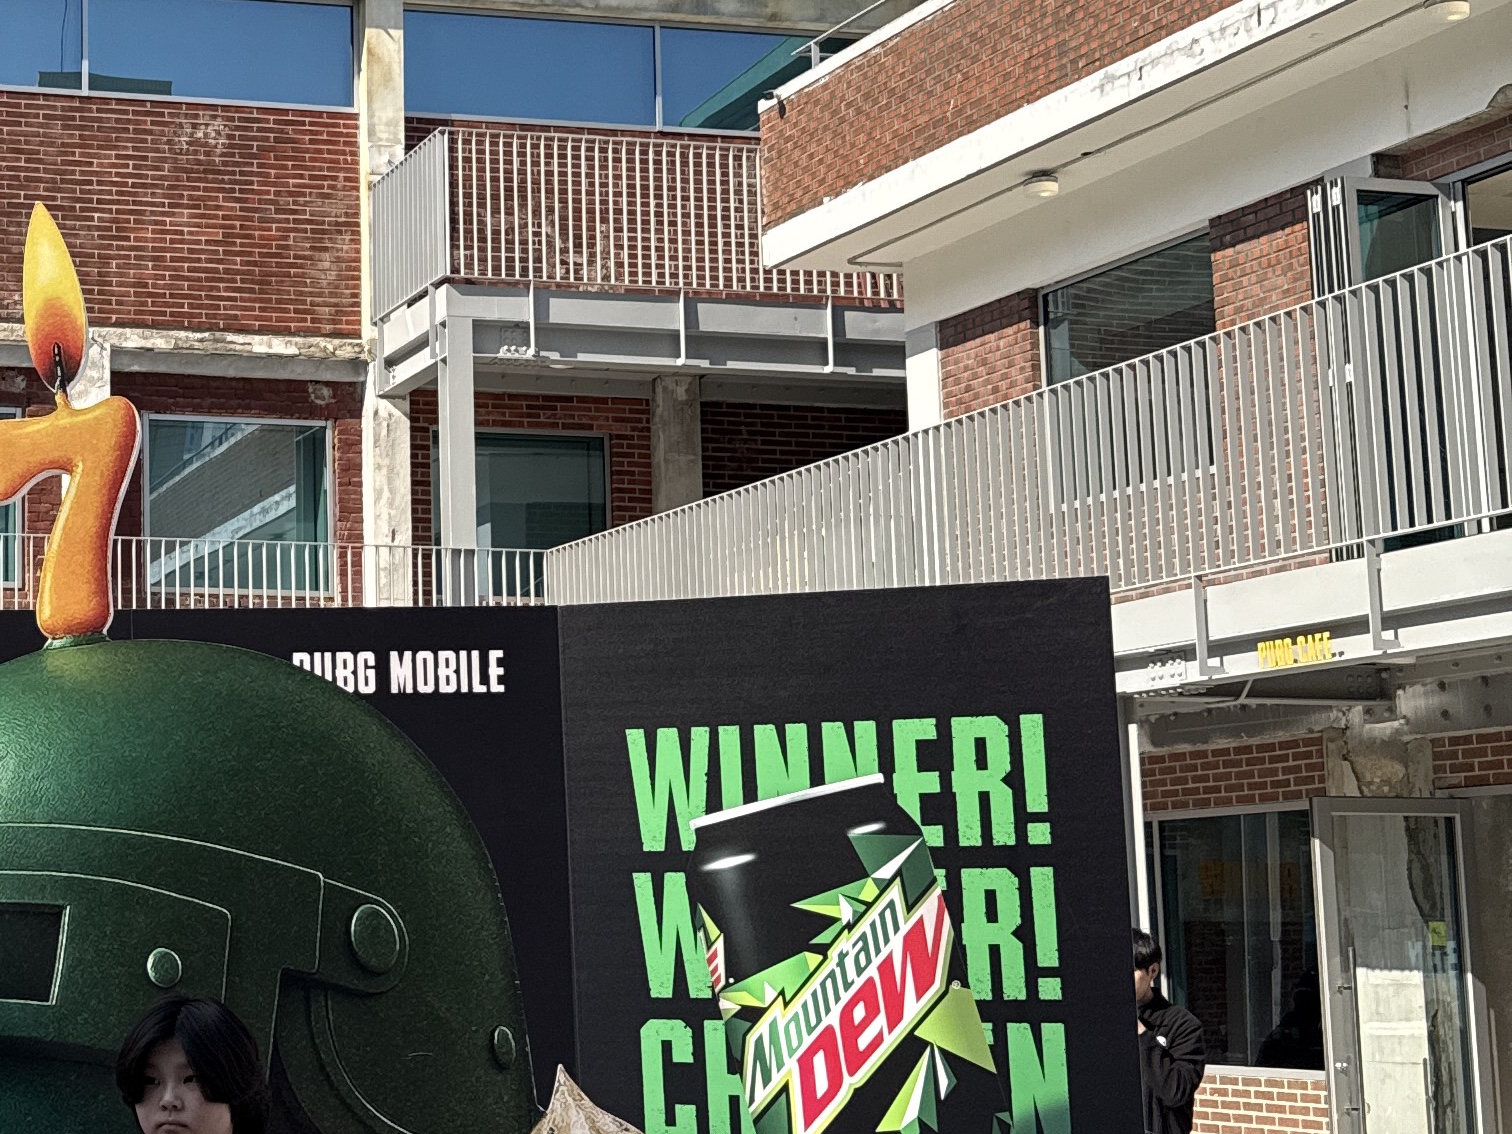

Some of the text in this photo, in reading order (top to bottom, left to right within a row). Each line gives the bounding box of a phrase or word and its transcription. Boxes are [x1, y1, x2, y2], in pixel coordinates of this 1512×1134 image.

[389, 649, 506, 694] MOBILE
[1257, 631, 1332, 669] PUBG CAFE
[748, 897, 901, 1108] Mountain
